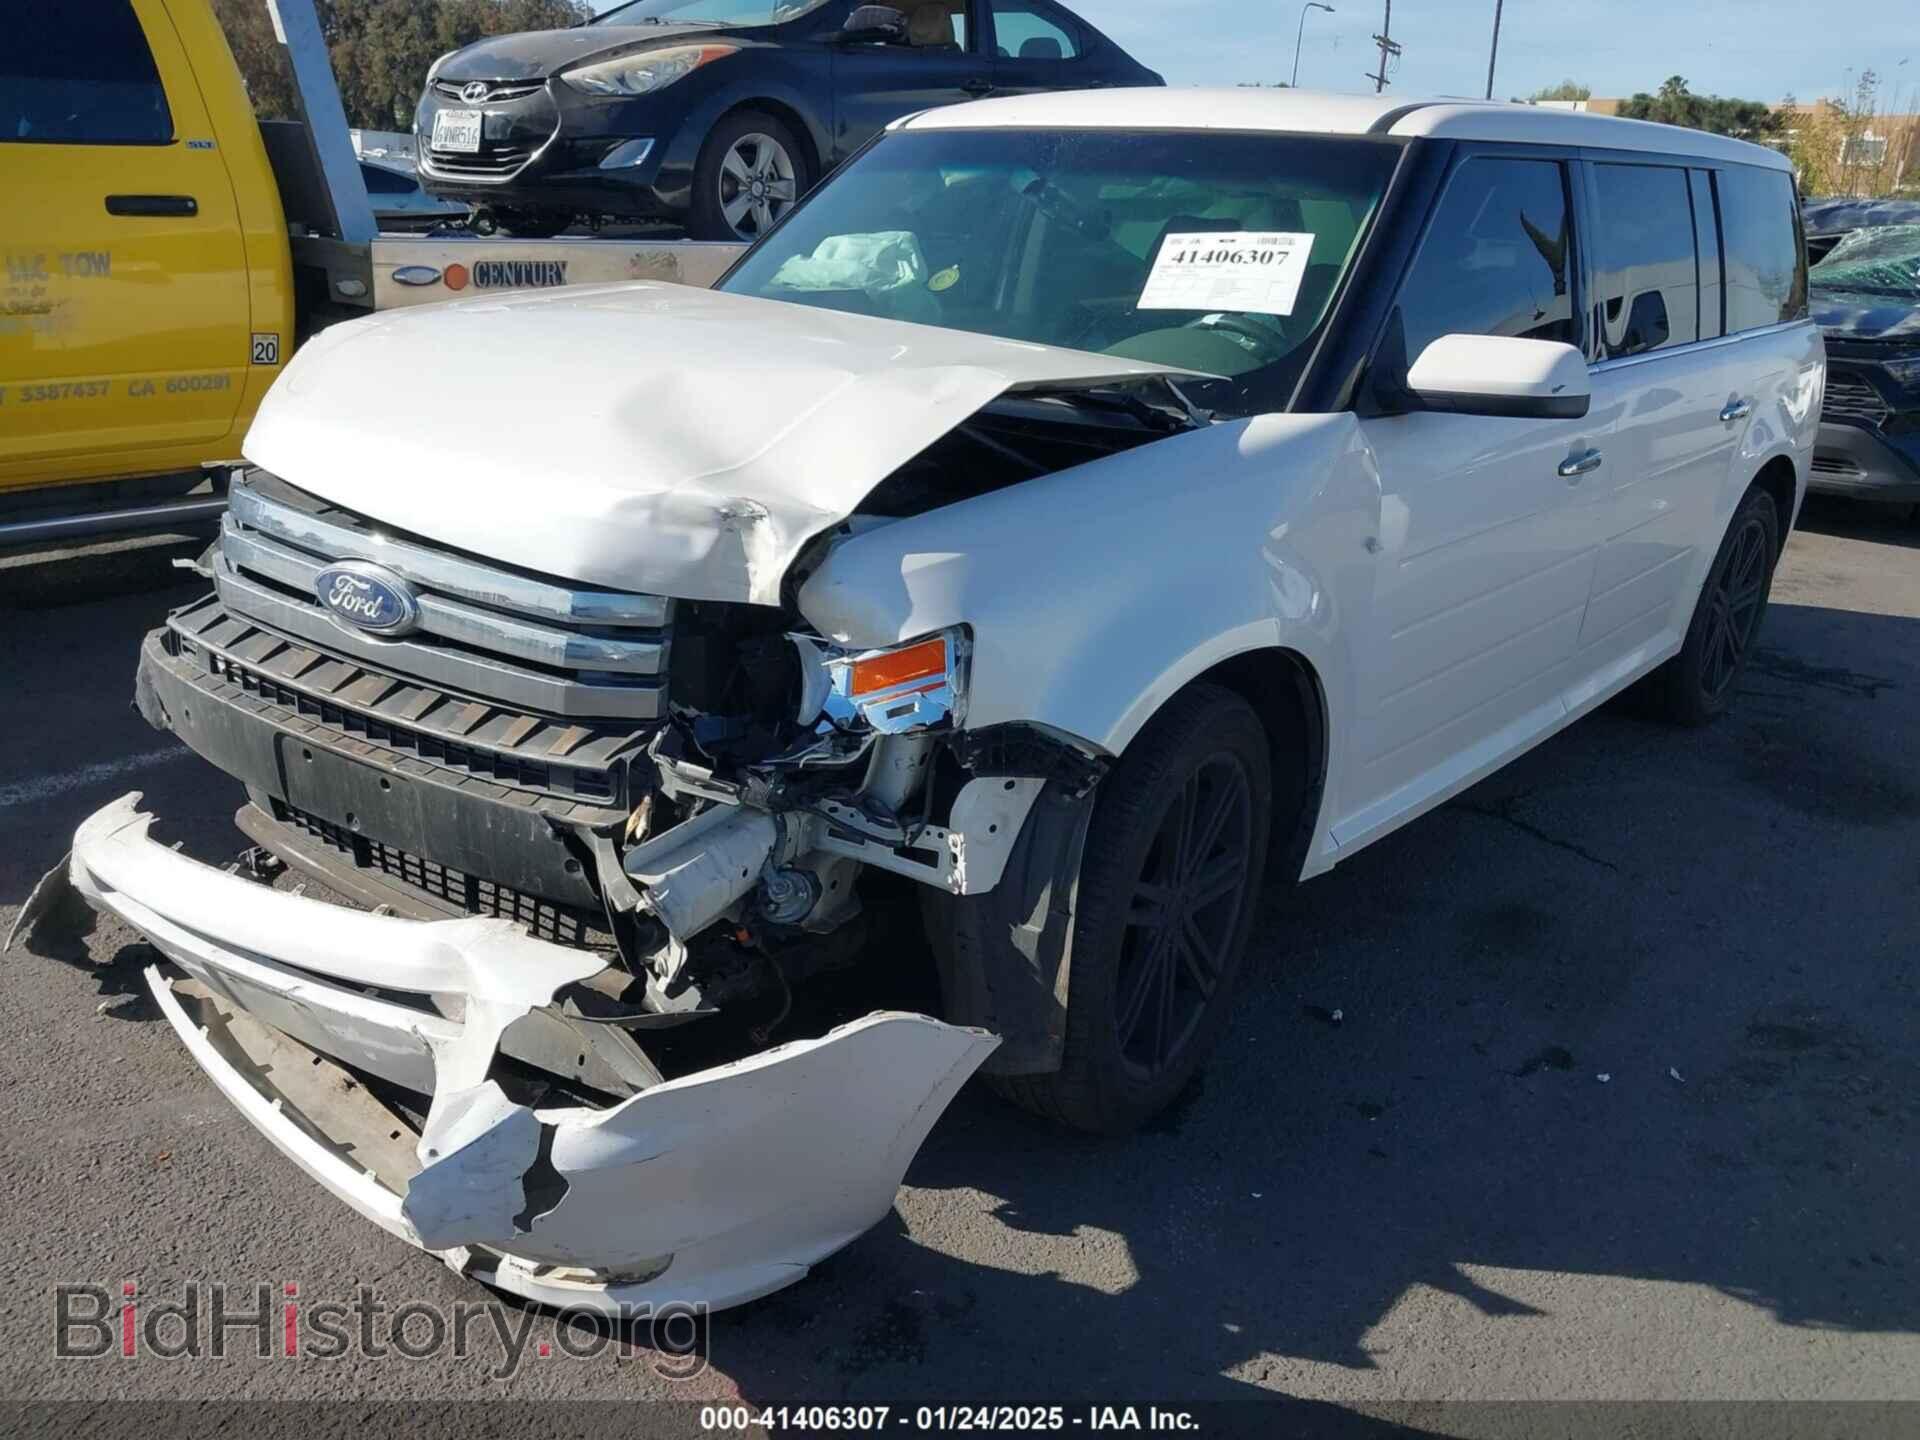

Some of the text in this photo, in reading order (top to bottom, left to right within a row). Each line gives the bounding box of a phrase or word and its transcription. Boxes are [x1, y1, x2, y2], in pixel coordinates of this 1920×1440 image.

[59, 251, 112, 278] TOW
[1171, 249, 1290, 266] 41406307
[473, 260, 568, 288] CENTURY
[255, 342, 276, 361] 20
[128, 380, 156, 397] CA
[328, 574, 384, 618] Ford
